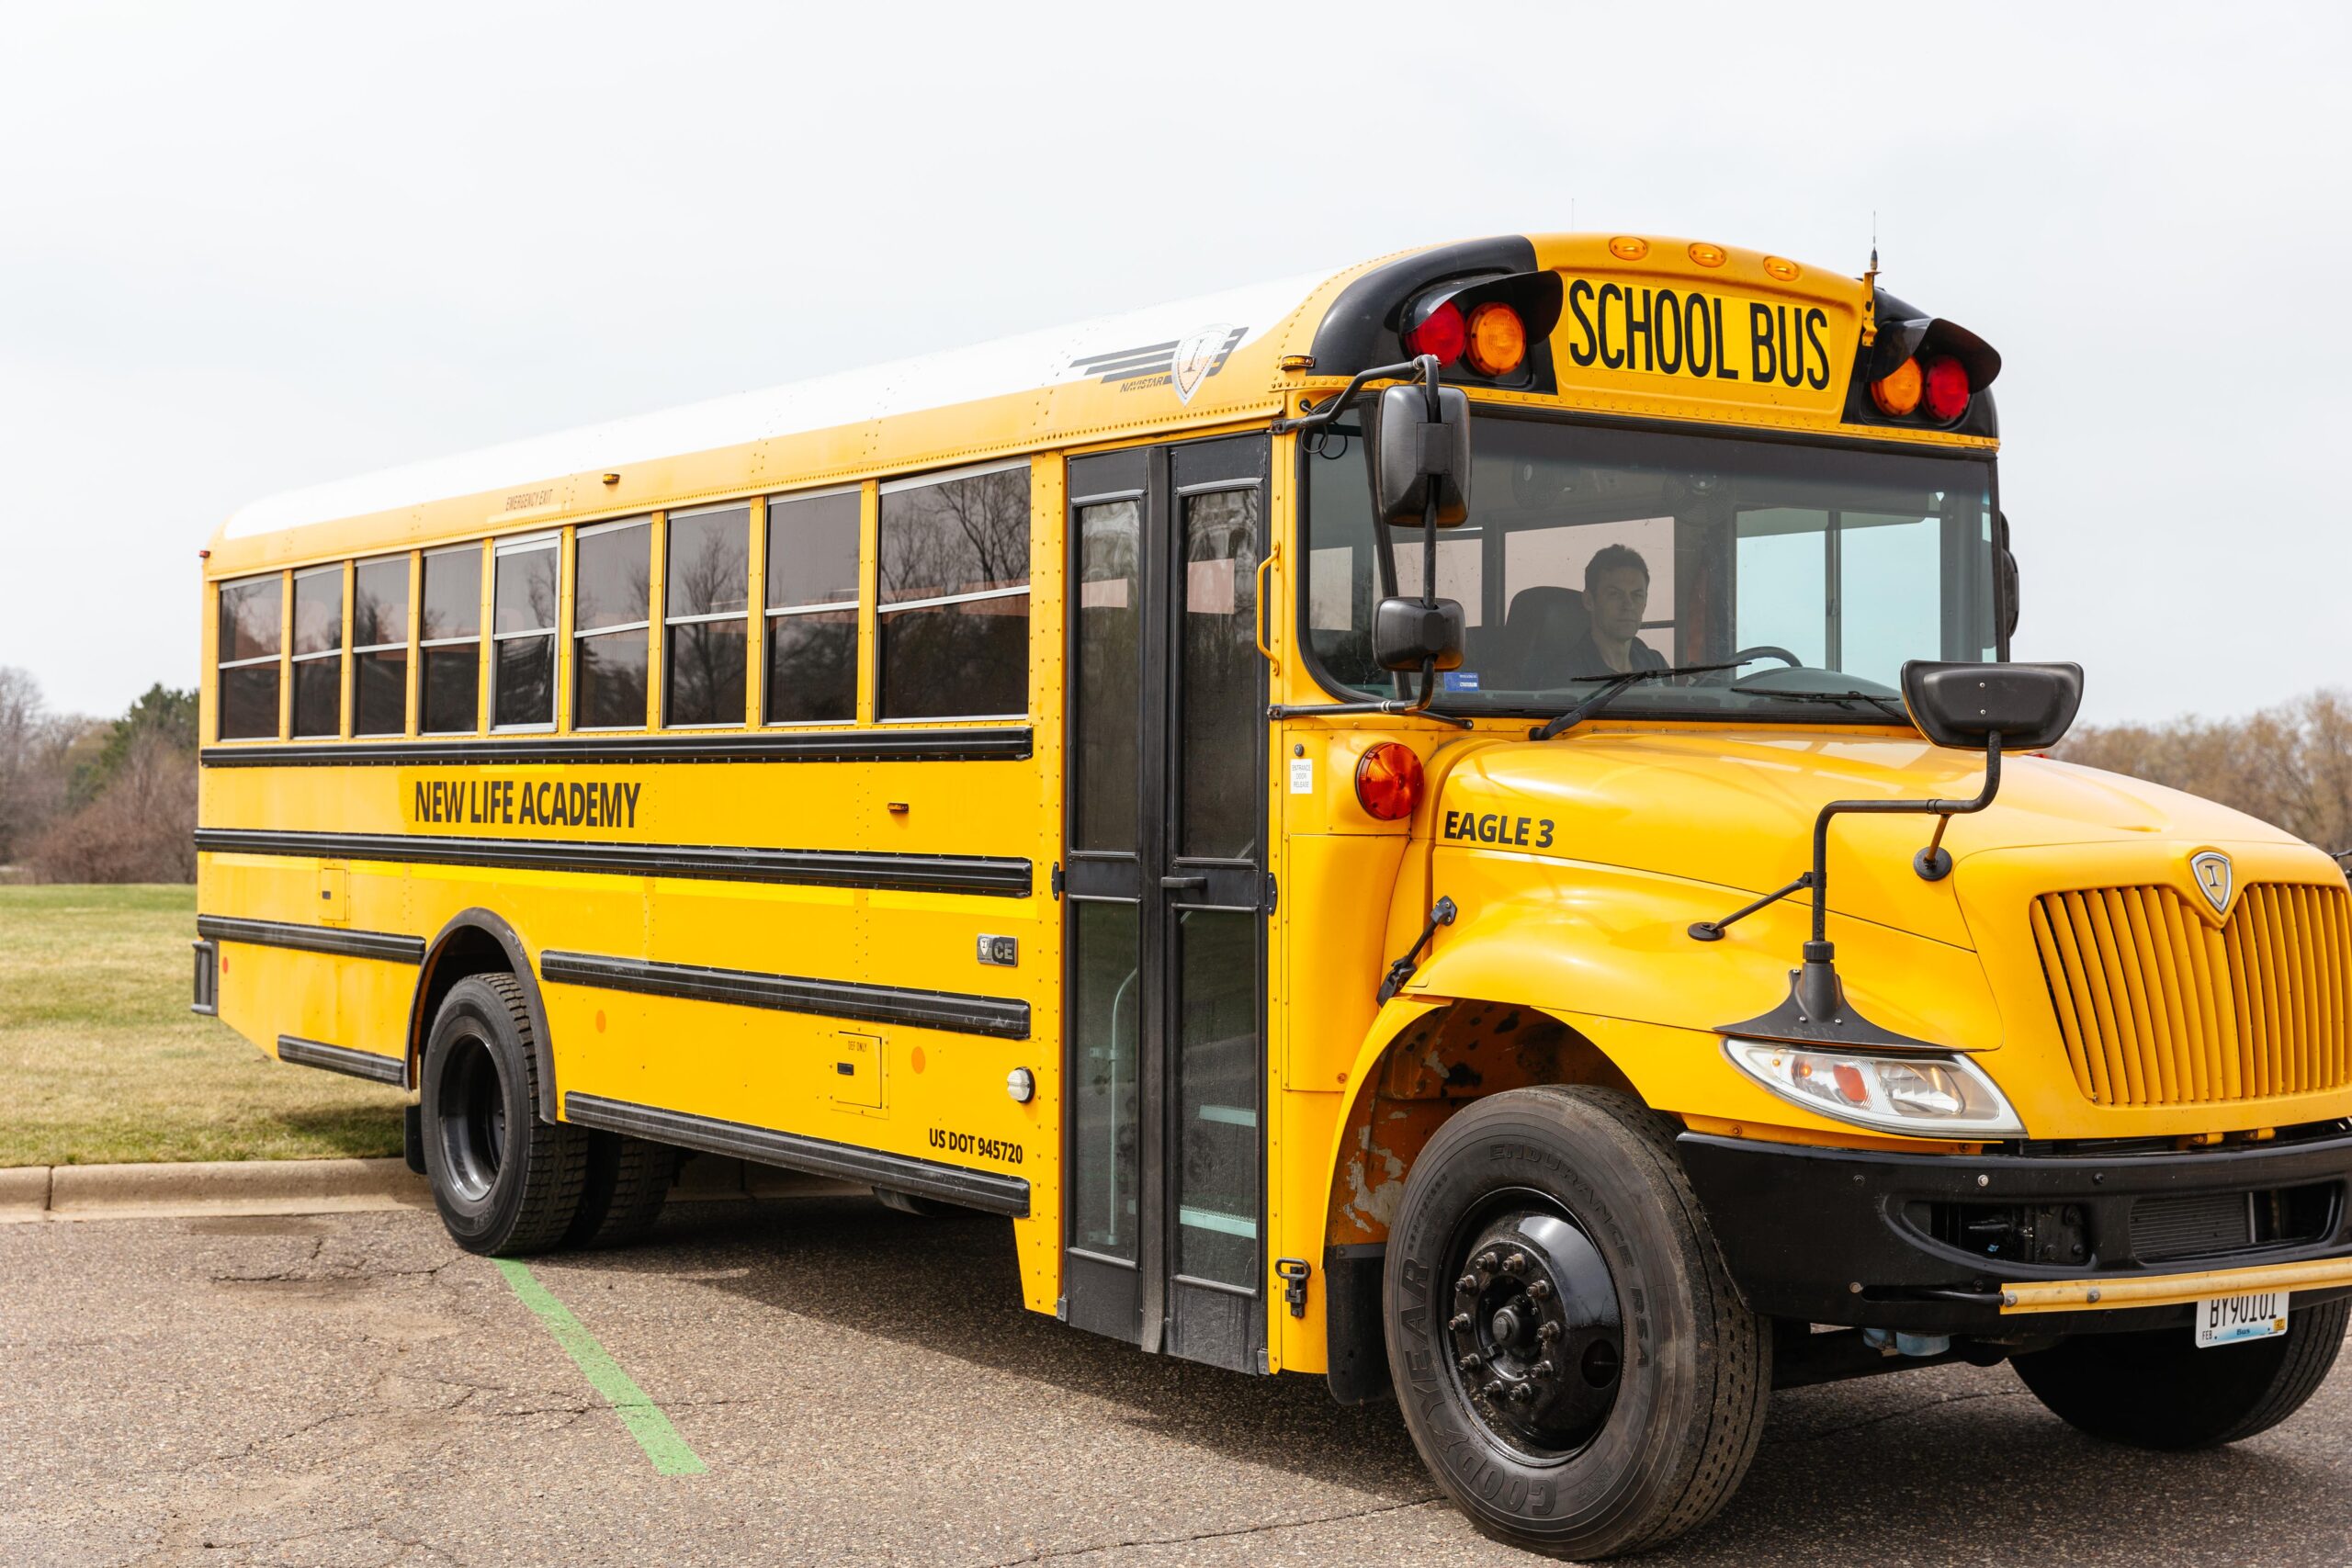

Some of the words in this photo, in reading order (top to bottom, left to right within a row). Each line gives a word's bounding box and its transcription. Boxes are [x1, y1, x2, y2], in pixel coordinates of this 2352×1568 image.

[1568, 278, 1738, 380] SCHOOL
[1749, 301, 1830, 390] BUS
[1120, 376, 1164, 393] NAVISTAR
[506, 492, 539, 511] EMERGENCY
[540, 490, 553, 504] EXIT
[415, 781, 466, 823] NEW
[470, 781, 514, 824] LIFE
[518, 782, 641, 829] ACADEMY
[1444, 810, 1532, 846] EAGLE
[1535, 818, 1555, 848] 3
[994, 942, 1013, 959] CE
[929, 1128, 945, 1148] US
[949, 1132, 975, 1154] DOT
[978, 1137, 1023, 1164] 945720
[1487, 1144, 1634, 1269] ENDURANCE
[1630, 1286, 1649, 1368] RSA
[2210, 1292, 2277, 1328] BY90101
[2202, 1330, 2212, 1340] FEB
[1401, 1258, 1555, 1516] GOODYEAR
